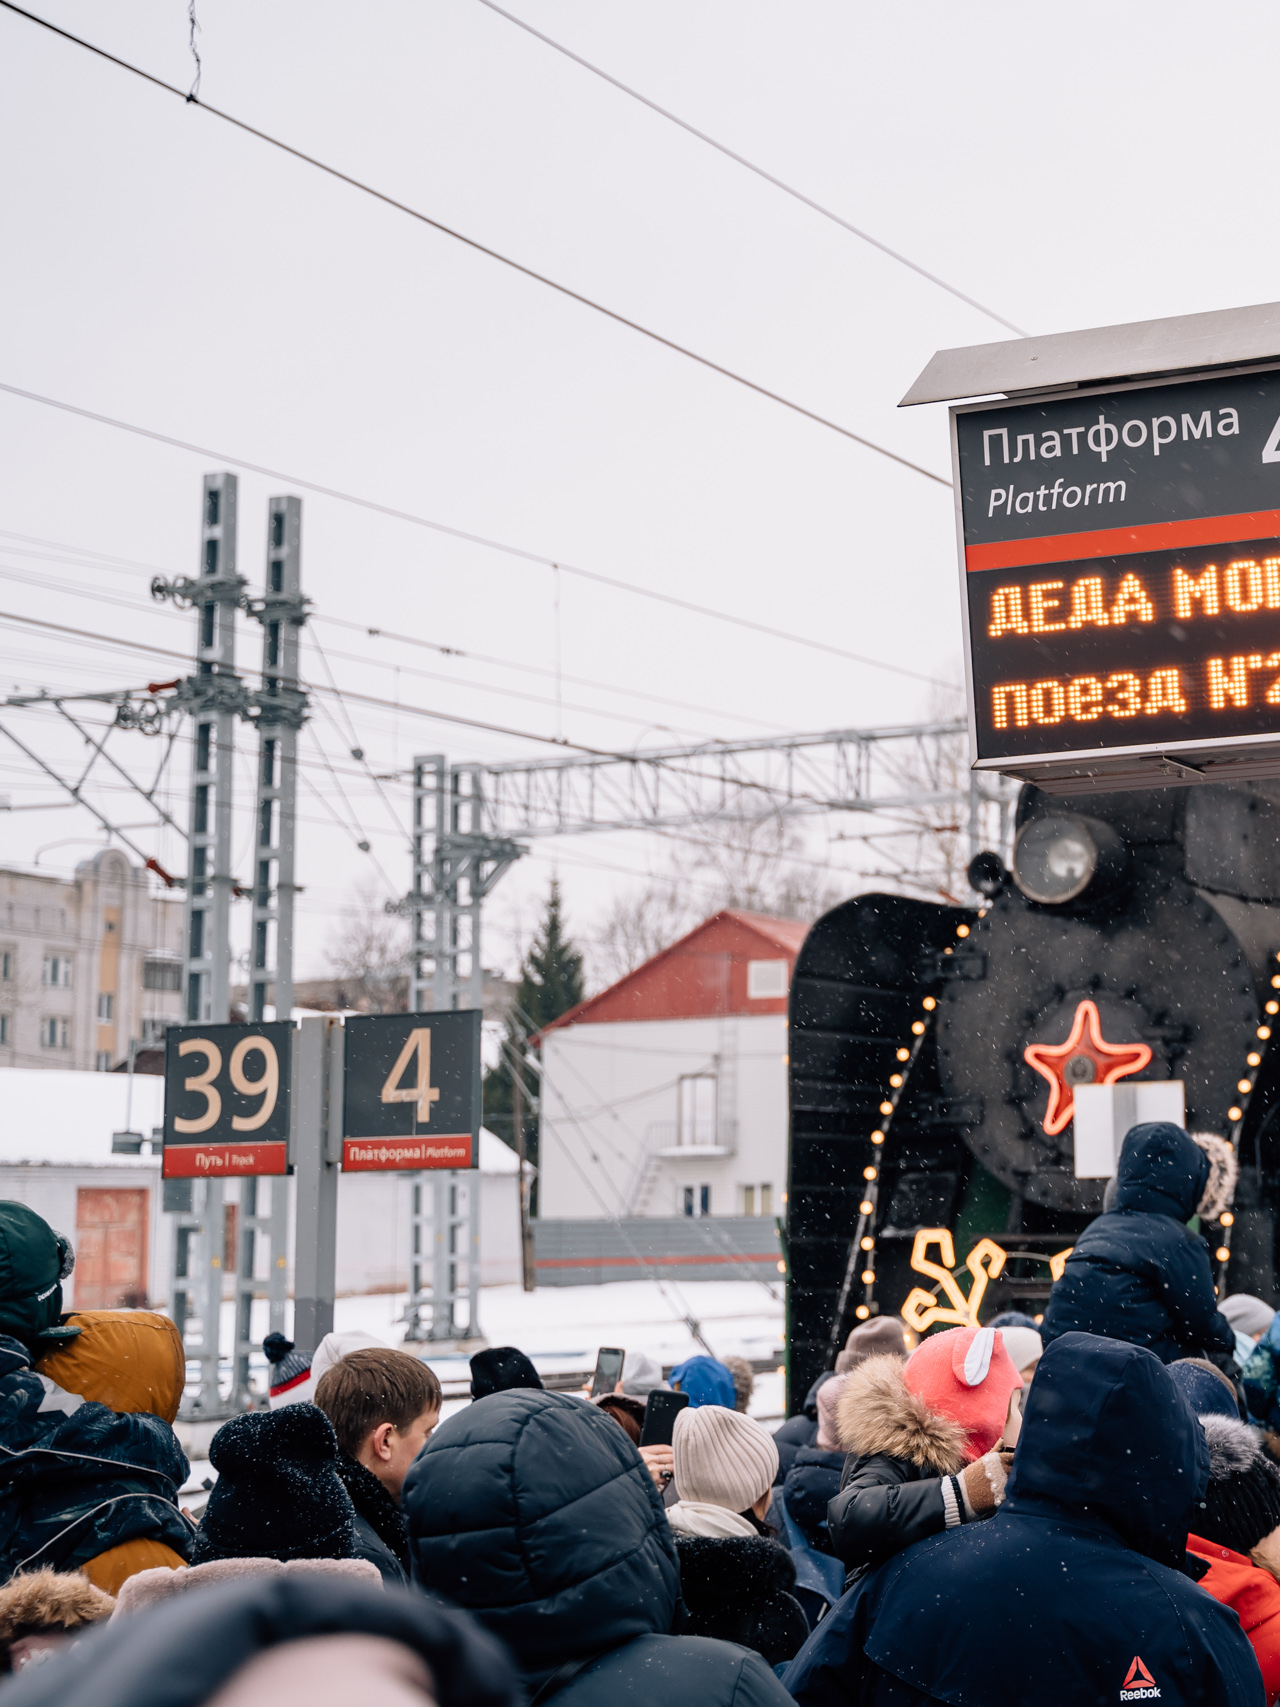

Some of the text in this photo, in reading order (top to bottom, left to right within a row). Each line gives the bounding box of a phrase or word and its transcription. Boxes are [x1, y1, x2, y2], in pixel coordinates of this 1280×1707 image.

[982, 406, 1241, 467] Платформа
[987, 477, 1128, 517] Platform
[988, 573, 1154, 637] ДЕДА
[173, 1035, 279, 1134] 39
[381, 1027, 440, 1123] 4
[195, 1152, 256, 1168] Путь Track
[349, 1146, 466, 1163] Платформа Platform
[1120, 1687, 1161, 1701] Reebok
